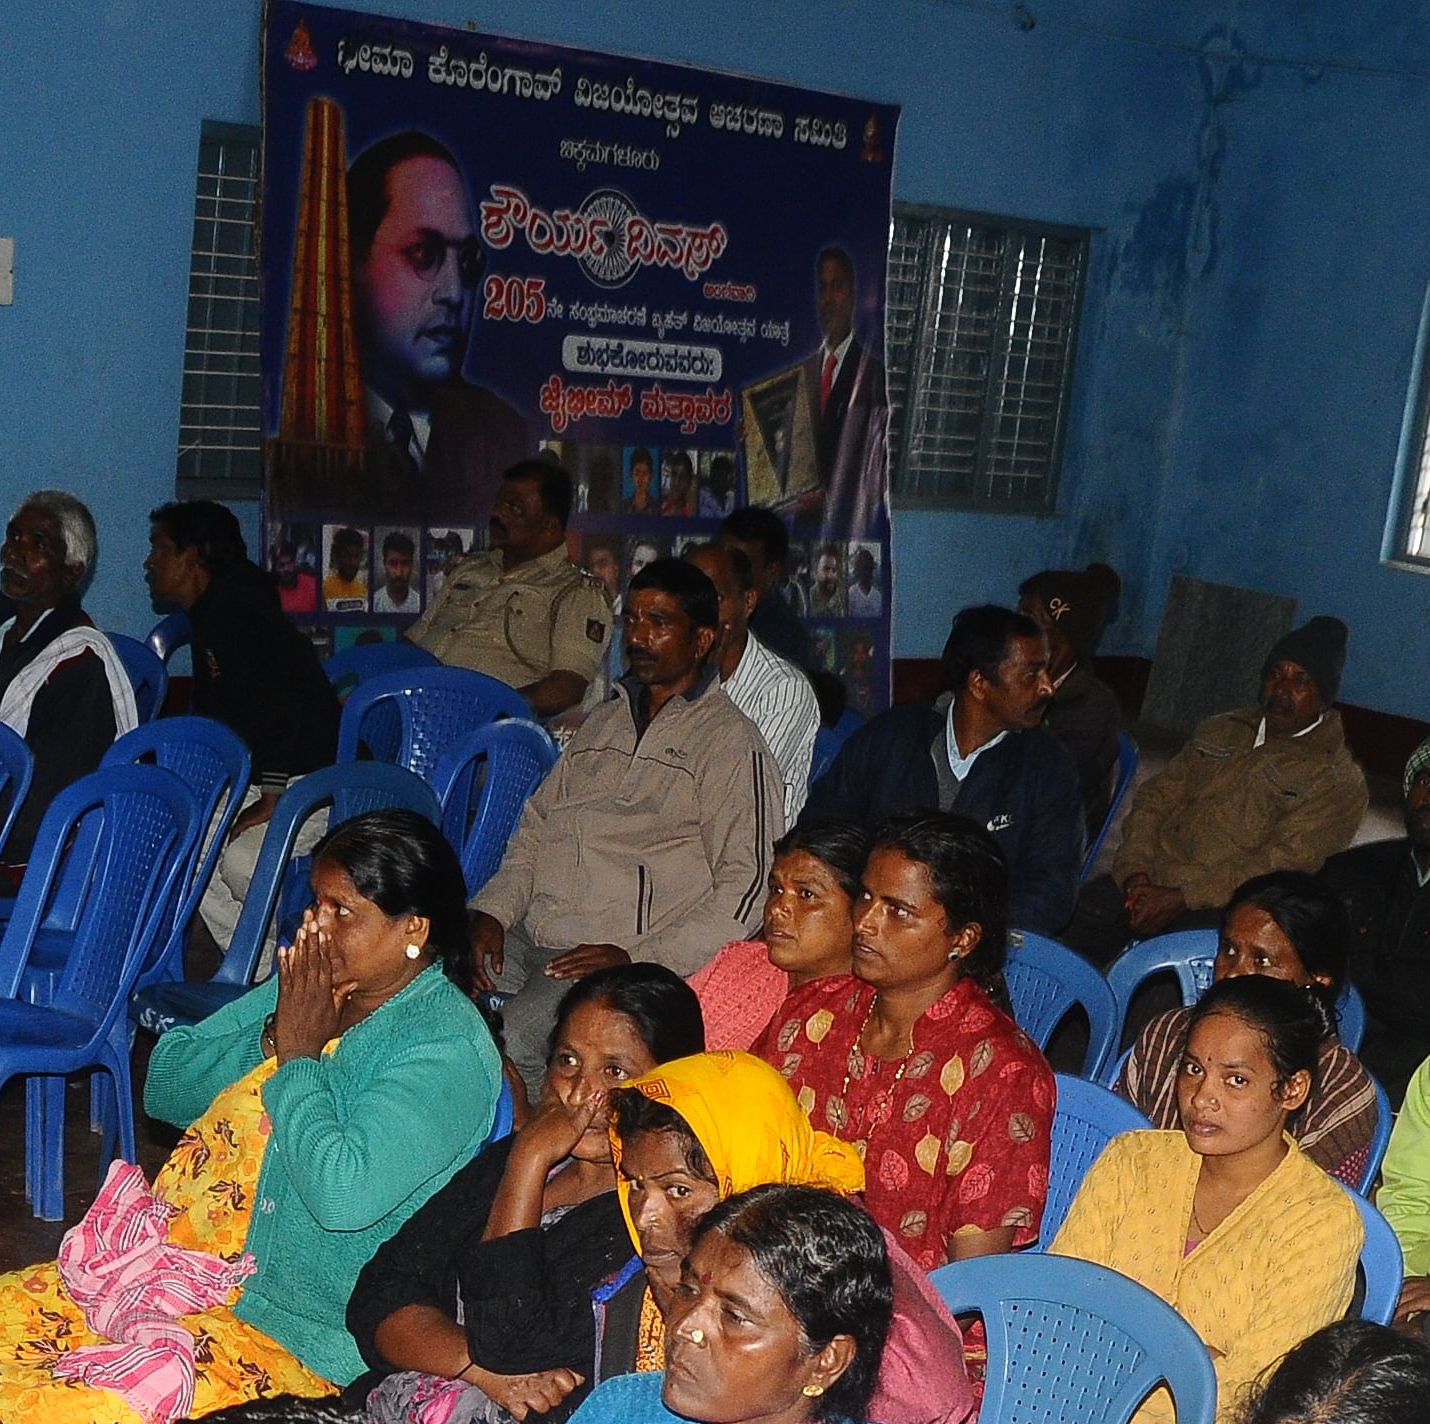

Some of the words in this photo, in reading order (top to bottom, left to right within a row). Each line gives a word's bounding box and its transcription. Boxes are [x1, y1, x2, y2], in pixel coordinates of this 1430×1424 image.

[337, 39, 414, 79] ಭೀಮಾ
[574, 76, 698, 138] ವಿಜಯೋತ್ಸವ
[794, 116, 848, 150] ಸಮಿತಿ
[559, 139, 660, 171] ಚಿಕ್ಕಮಗಳೂರು
[480, 184, 611, 257] ಶೌರ್ಯ
